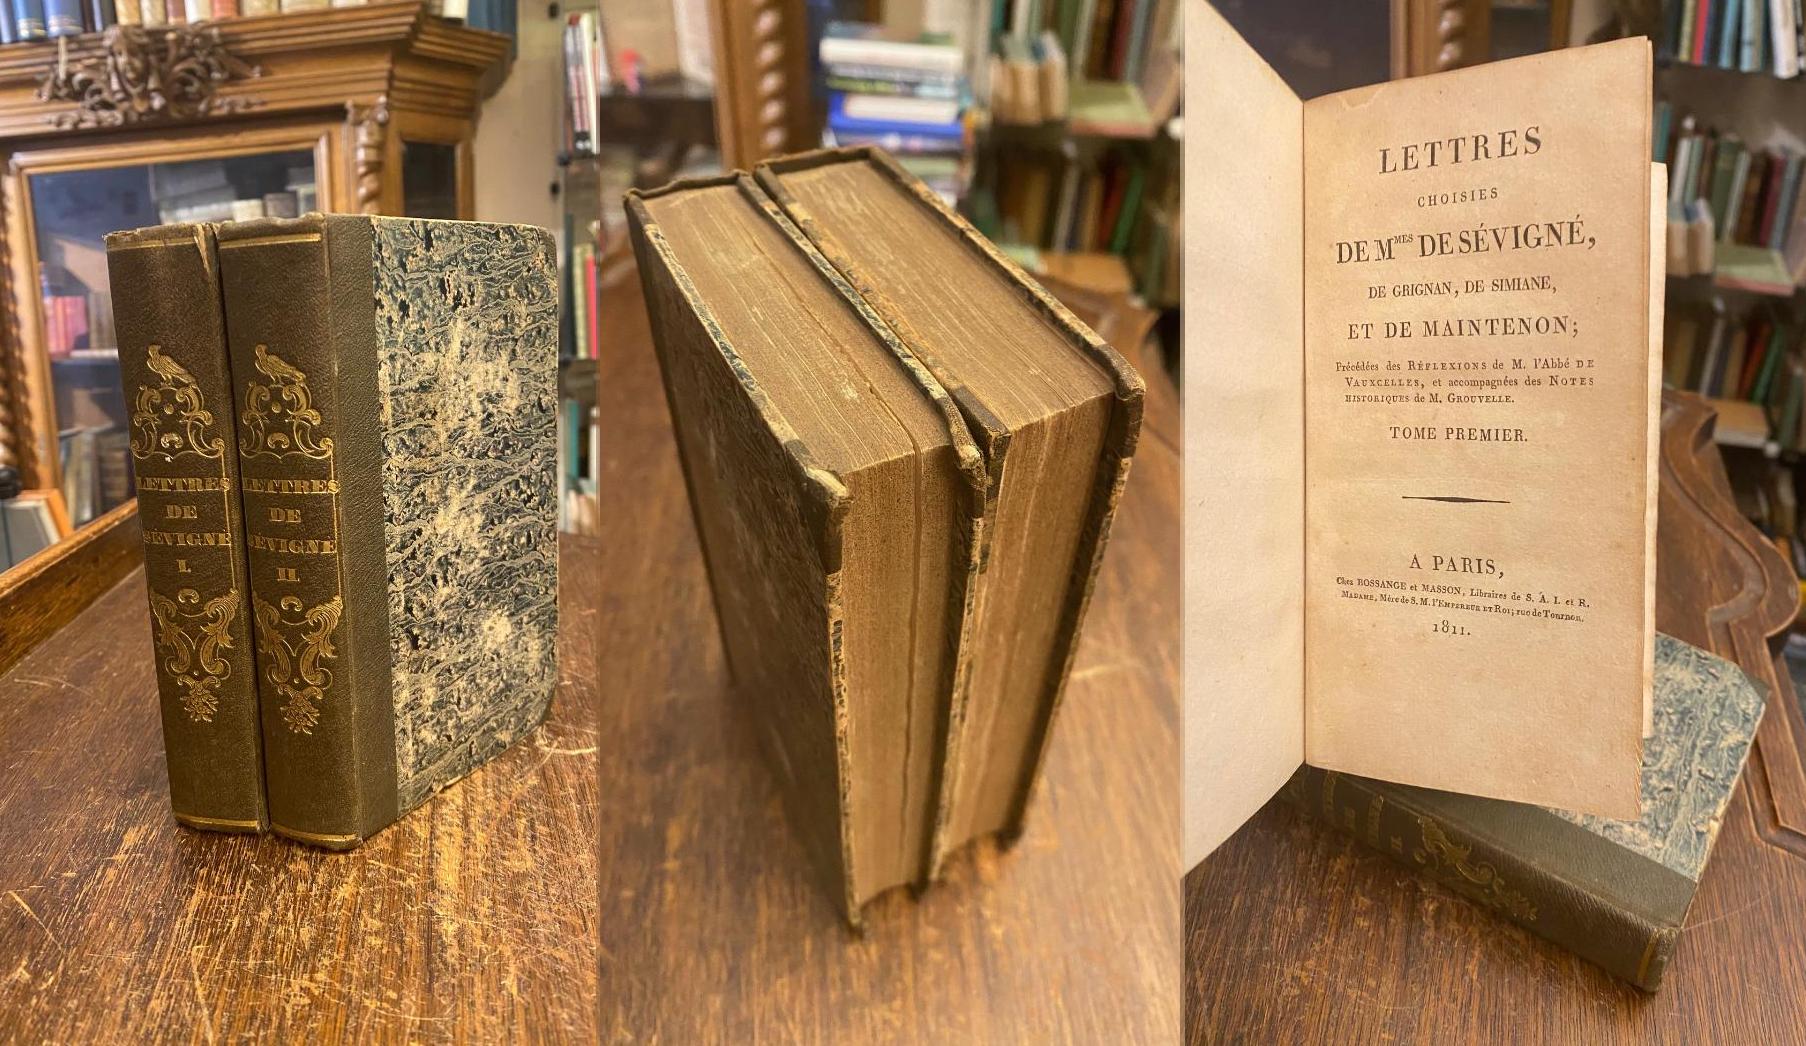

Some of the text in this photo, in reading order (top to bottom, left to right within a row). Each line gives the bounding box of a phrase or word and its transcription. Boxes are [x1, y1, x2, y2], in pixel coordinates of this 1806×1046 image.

[1378, 126, 1542, 174] LETTRES
[1417, 187, 1499, 207] CHOISIES
[1336, 240, 1370, 264] DE
[1417, 232, 1454, 258] DE
[1458, 214, 1596, 254] SÉVIGNÉ,
[1368, 276, 1558, 299] DE GRIGNAN, DE SIMIANE,
[1347, 315, 1579, 340] ET DE MAINTENON;
[1335, 360, 1379, 372] Précédées
[1386, 360, 1401, 371] des
[1492, 359, 1504, 370] de
[1511, 358, 1526, 370] M.
[1533, 357, 1570, 369] l'Abbé
[1576, 359, 1594, 369] DE
[1345, 375, 1594, 390] VAUXCELLES, et accompagnées des NOTES
[1345, 393, 1515, 404] HISTORIQUES de M. GROUVELLE.
[1390, 426, 1528, 442] TOME PREMIER.
[165, 504, 198, 519] DE
[268, 507, 302, 522] DE
[1409, 553, 1504, 579] A PARIS,
[1357, 578, 1407, 590] BOSSANGE
[1410, 584, 1418, 592] et
[1421, 583, 1466, 597] MASSON,
[1470, 588, 1507, 600] Libraires
[1511, 591, 1521, 601] de
[1525, 593, 1535, 603] S.
[1578, 598, 1590, 608] R.
[1380, 593, 1399, 604] Mère
[1400, 595, 1409, 604] de
[1411, 596, 1419, 605] S.
[1420, 597, 1431, 607] M.
[1516, 608, 1530, 616] rue
[1531, 608, 1542, 618] de
[1432, 619, 1471, 636] 1811.
